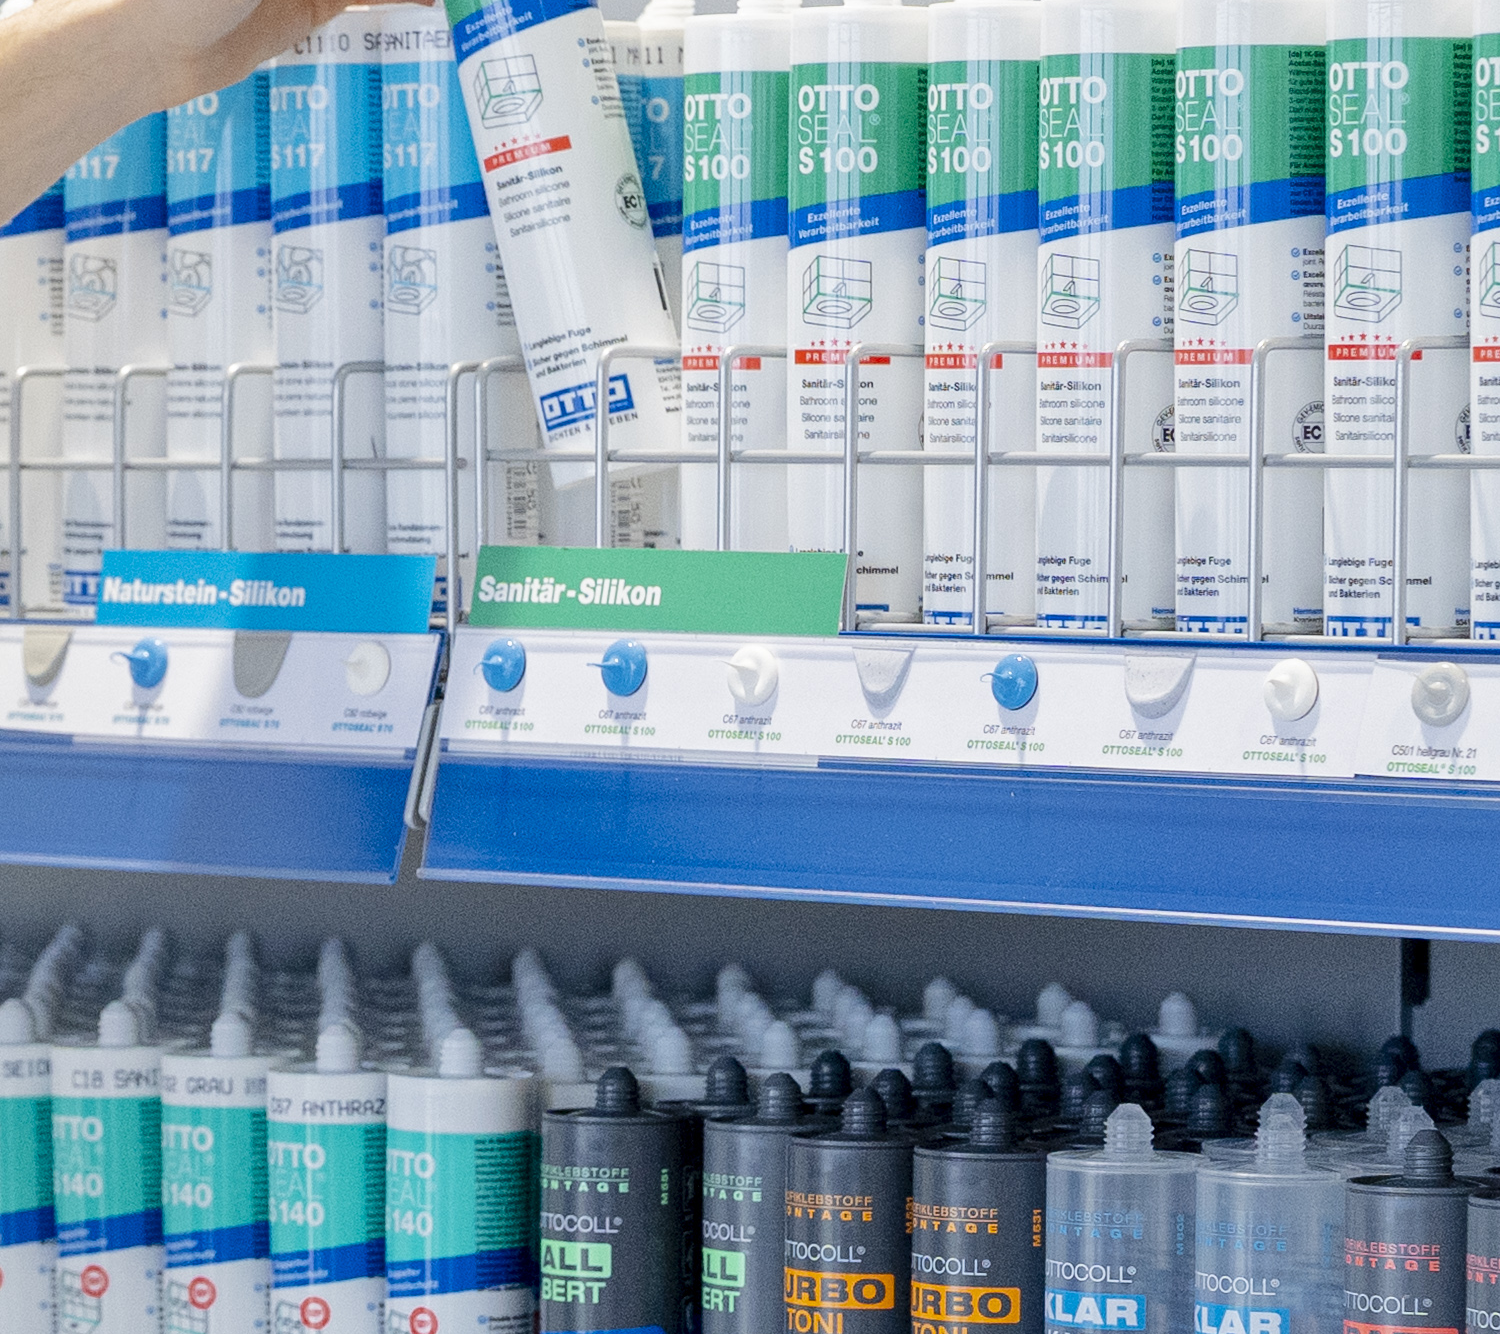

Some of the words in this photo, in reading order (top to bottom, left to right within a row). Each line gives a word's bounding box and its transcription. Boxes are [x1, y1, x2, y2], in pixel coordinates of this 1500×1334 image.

[464, 6, 513, 35] Exzellente
[1329, 61, 1410, 92] OTTO
[798, 83, 880, 114] OTTO
[1329, 129, 1343, 158] S
[1346, 127, 1408, 157] 100
[799, 147, 814, 175] S
[819, 146, 879, 173] 100
[497, 164, 563, 190] Sanitär-Silikon
[807, 206, 861, 224] Exzellente
[787, 1308, 843, 1334] TONI
